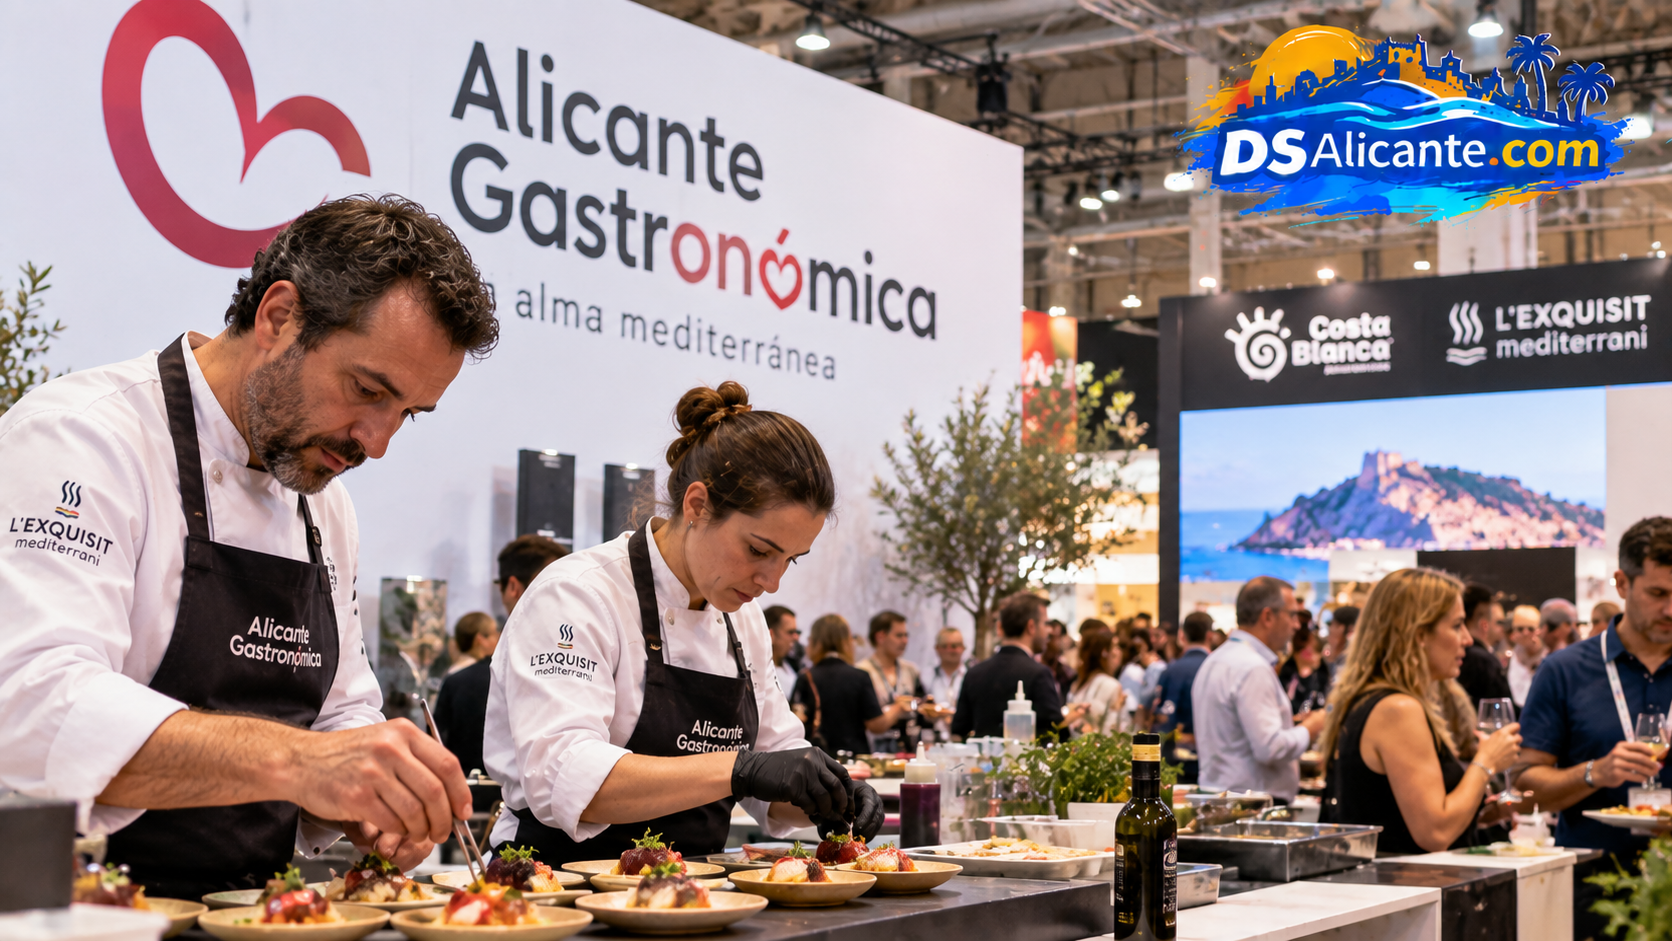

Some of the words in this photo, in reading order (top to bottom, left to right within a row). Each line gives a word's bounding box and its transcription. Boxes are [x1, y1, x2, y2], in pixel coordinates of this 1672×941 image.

[450, 40, 764, 202] Alicante
[450, 142, 937, 340] Gastronómica
[1308, 312, 1391, 341] Costa
[1495, 294, 1652, 332] L'EXQUISIT
[515, 281, 602, 333] alma
[620, 311, 837, 381] mediterránea
[1496, 324, 1648, 359] mediterrani
[1291, 338, 1392, 366] Blanca
[9, 517, 114, 554] L'EXQUISIT
[14, 537, 101, 566] mediterrani
[247, 615, 310, 645] Alicante
[229, 634, 322, 668] Gastronómica
[530, 652, 598, 672] L'EXQUISIT
[691, 719, 744, 740] Alicante
